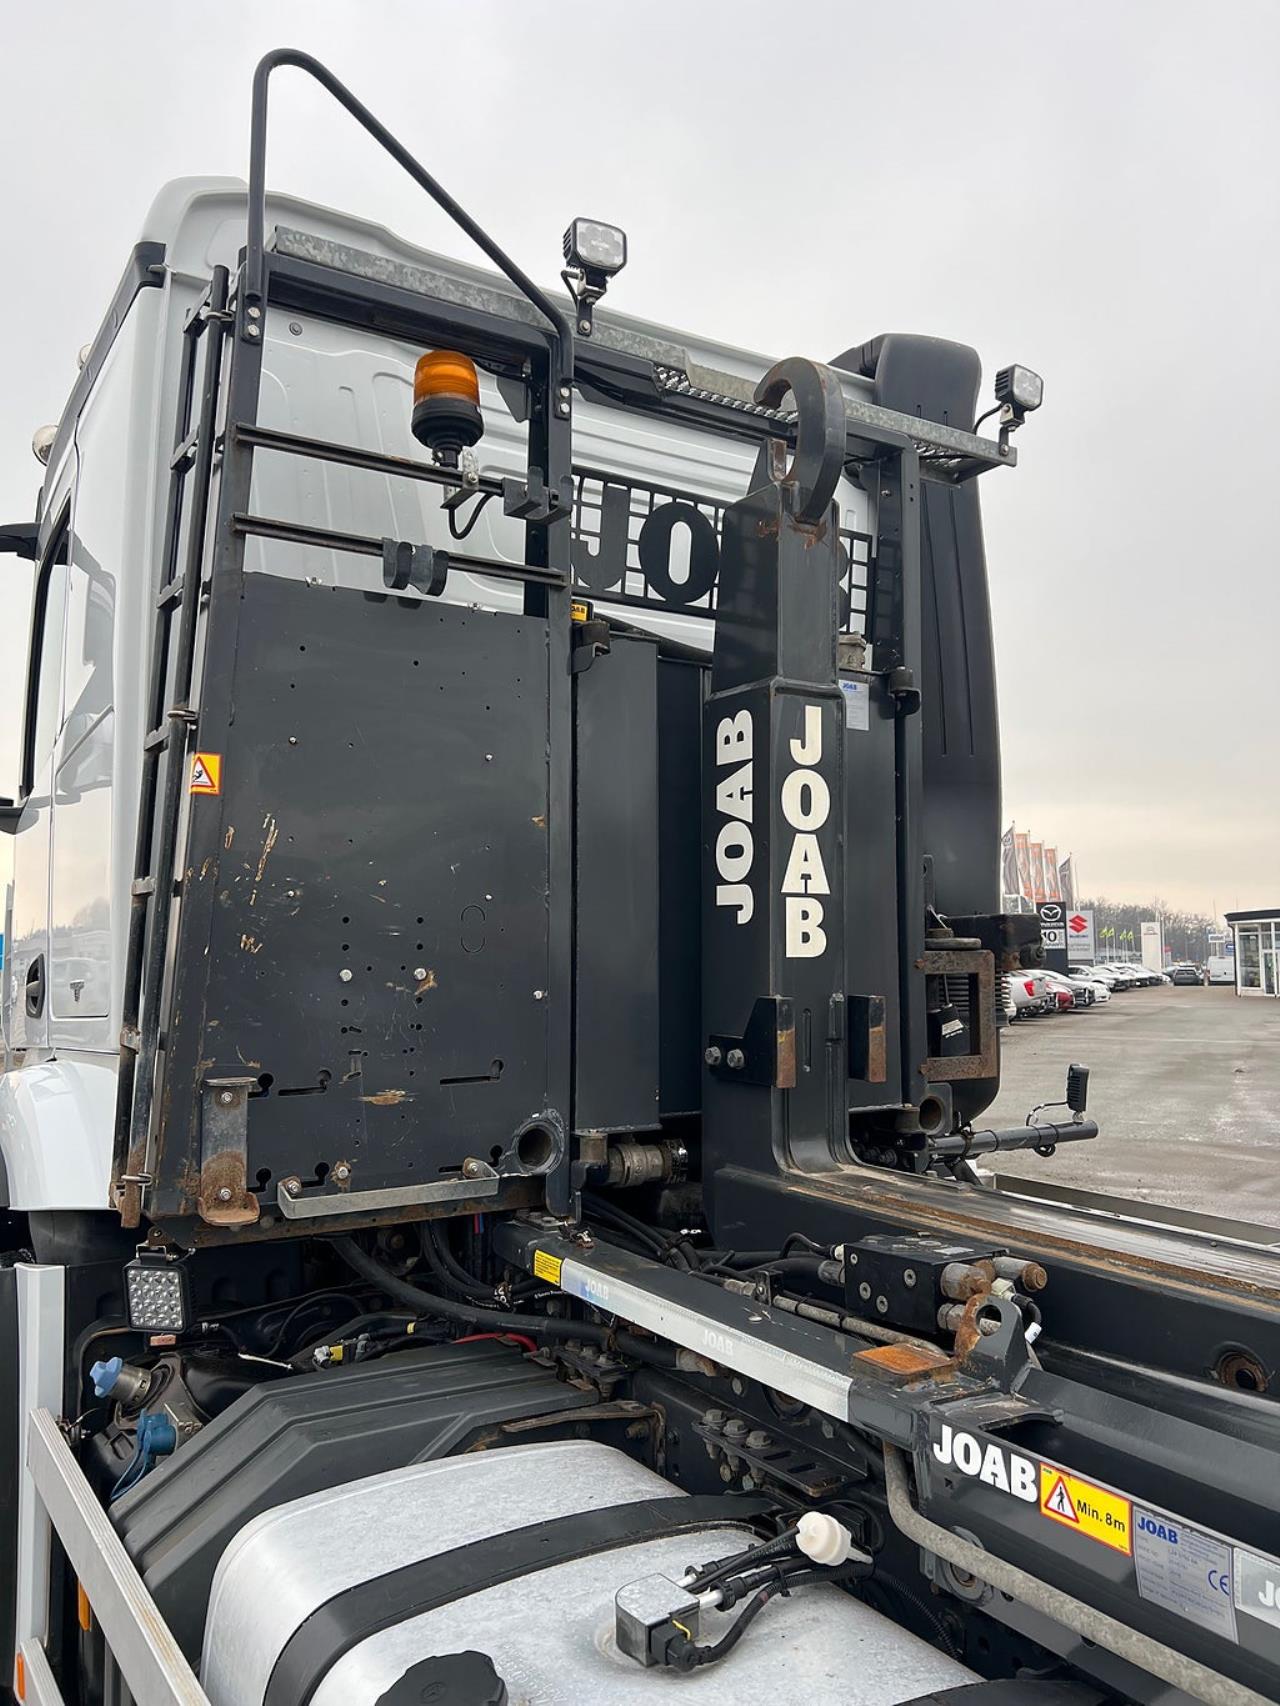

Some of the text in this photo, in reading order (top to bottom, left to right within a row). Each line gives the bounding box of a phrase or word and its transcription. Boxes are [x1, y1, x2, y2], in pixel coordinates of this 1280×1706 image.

[716, 709, 754, 925] JOAB
[781, 705, 830, 958] JOAB
[584, 1278, 609, 1300] JOAB
[702, 1328, 734, 1355] JOAB
[933, 1424, 1038, 1503] JOAB
[1077, 1500, 1103, 1522] Min.
[1138, 1516, 1179, 1544] JOAB
[1258, 1580, 1280, 1611] J
